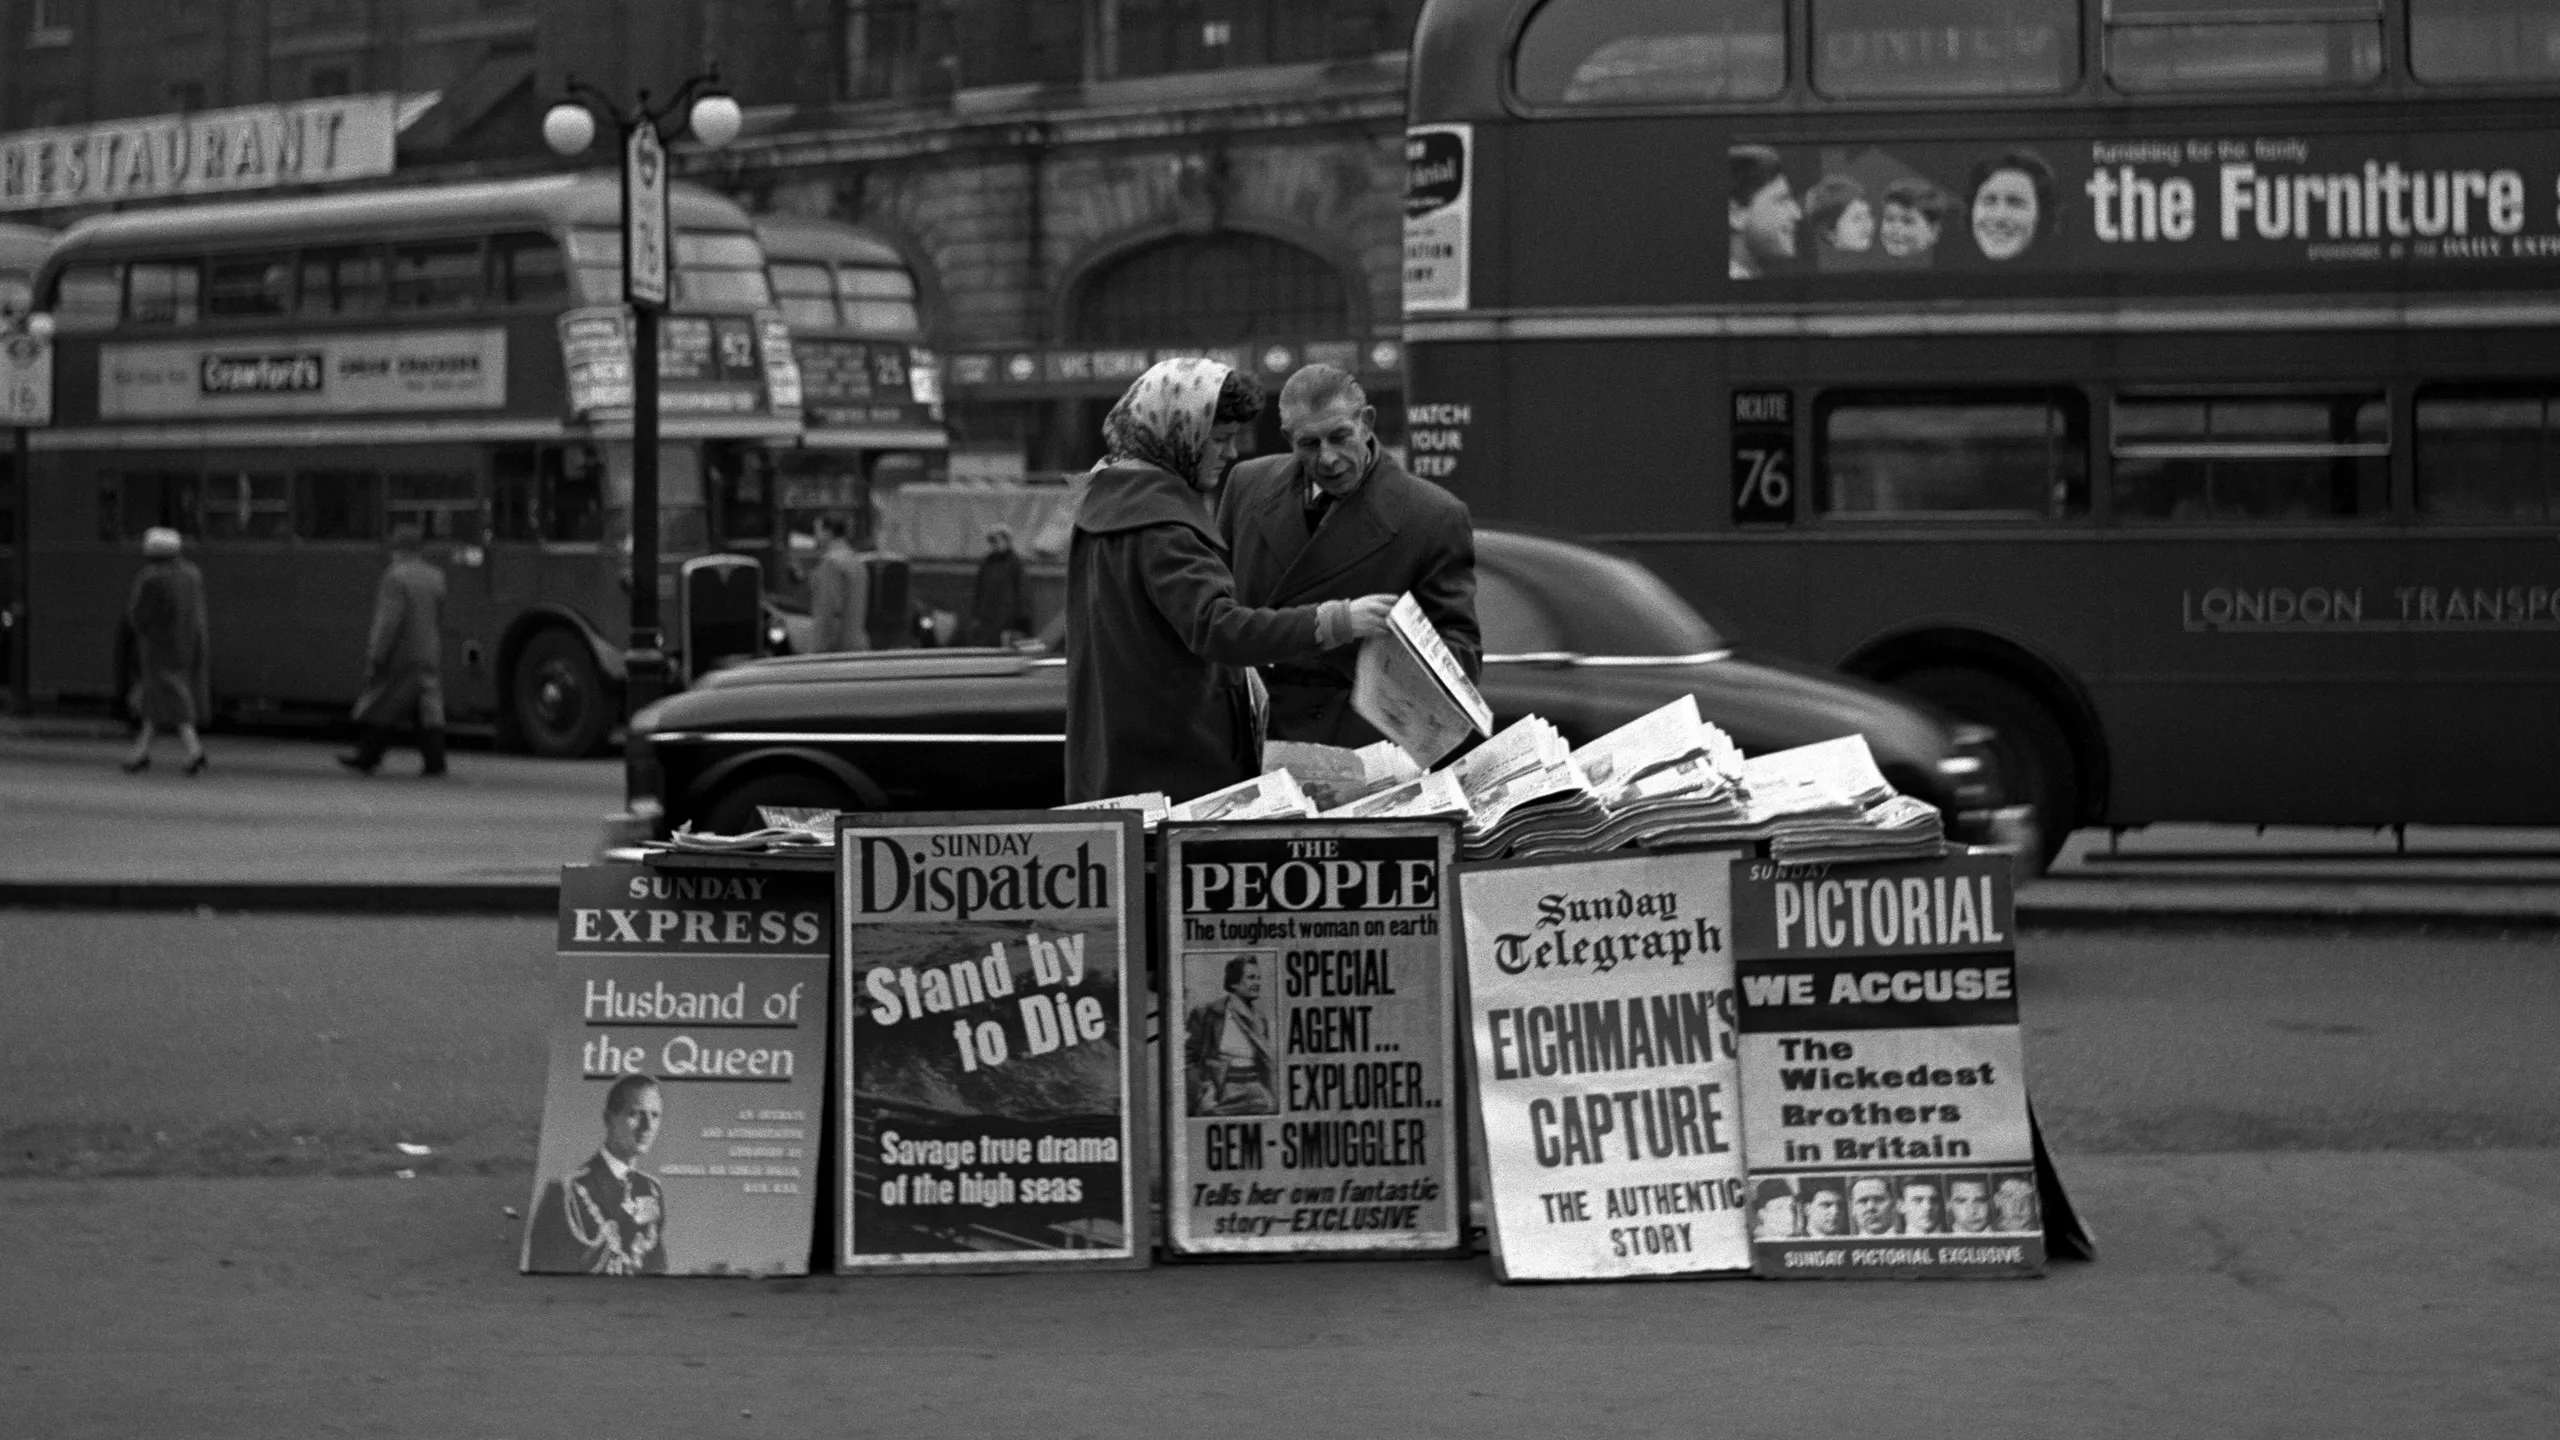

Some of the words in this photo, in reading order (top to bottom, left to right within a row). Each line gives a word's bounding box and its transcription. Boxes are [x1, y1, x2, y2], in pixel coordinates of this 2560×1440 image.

[3, 110, 343, 197] RESTAURANT
[2085, 164, 2196, 242] the
[2220, 159, 2524, 241] Furniture
[1737, 450, 1790, 508] 76
[2183, 588, 2363, 628] LONDON
[932, 833, 1033, 857] SUNDAY
[1287, 840, 1339, 858] THE
[629, 876, 767, 899] SUNDAY
[860, 836, 1109, 920] Dispatch
[1185, 860, 1437, 912] PEOPLE
[572, 908, 820, 944] EXPRESS
[1184, 917, 1215, 940] The
[1219, 918, 1296, 944] toughest
[1300, 923, 1360, 938] woman
[1365, 919, 1385, 936] on
[1390, 914, 1437, 936] earth
[1535, 888, 1678, 930] Sunday
[1775, 875, 2004, 949] PICTORIAL
[1494, 917, 1721, 975] Telegraph
[866, 941, 1015, 1026] Stand
[1026, 932, 1084, 987] by
[1285, 949, 1395, 997] SPECIAL
[1742, 974, 1816, 1006] WE
[1828, 967, 2012, 1004] ACCUSE
[585, 979, 745, 1020] Husband
[763, 981, 804, 1021] of
[953, 1018, 1008, 1072] to
[1019, 992, 1106, 1056] Die
[1488, 988, 1737, 1081] EICHMANN'S
[1778, 1038, 1853, 1061] The
[584, 1034, 645, 1074] the
[662, 1035, 794, 1076] Queen
[1778, 1062, 1995, 1091] Wickedest
[1529, 1083, 1729, 1167] CAPTURE
[1781, 1102, 1961, 1127] Brothers
[881, 1130, 976, 1170] Savage
[980, 1135, 1032, 1164] true
[1037, 1135, 1119, 1164] drama
[1784, 1140, 1821, 1162] in
[1833, 1135, 1971, 1160] Britain
[881, 1174, 908, 1206] of
[912, 1172, 954, 1205] the
[959, 1172, 1015, 1208] high
[1020, 1177, 1083, 1203] seas
[1193, 1182, 1242, 1207] Tells
[1247, 1182, 1285, 1205] her
[1290, 1186, 1335, 1204] own
[1340, 1176, 1440, 1203] fantastic
[1539, 1191, 1591, 1224] THE
[1606, 1178, 1746, 1219] AUTHENTIC
[1609, 1223, 1692, 1257] STORY
[1784, 1250, 1846, 1267] SUNDAY
[1851, 1248, 1934, 1265] PICTORIAL
[1938, 1246, 2024, 1263] EXCLUSIVE
